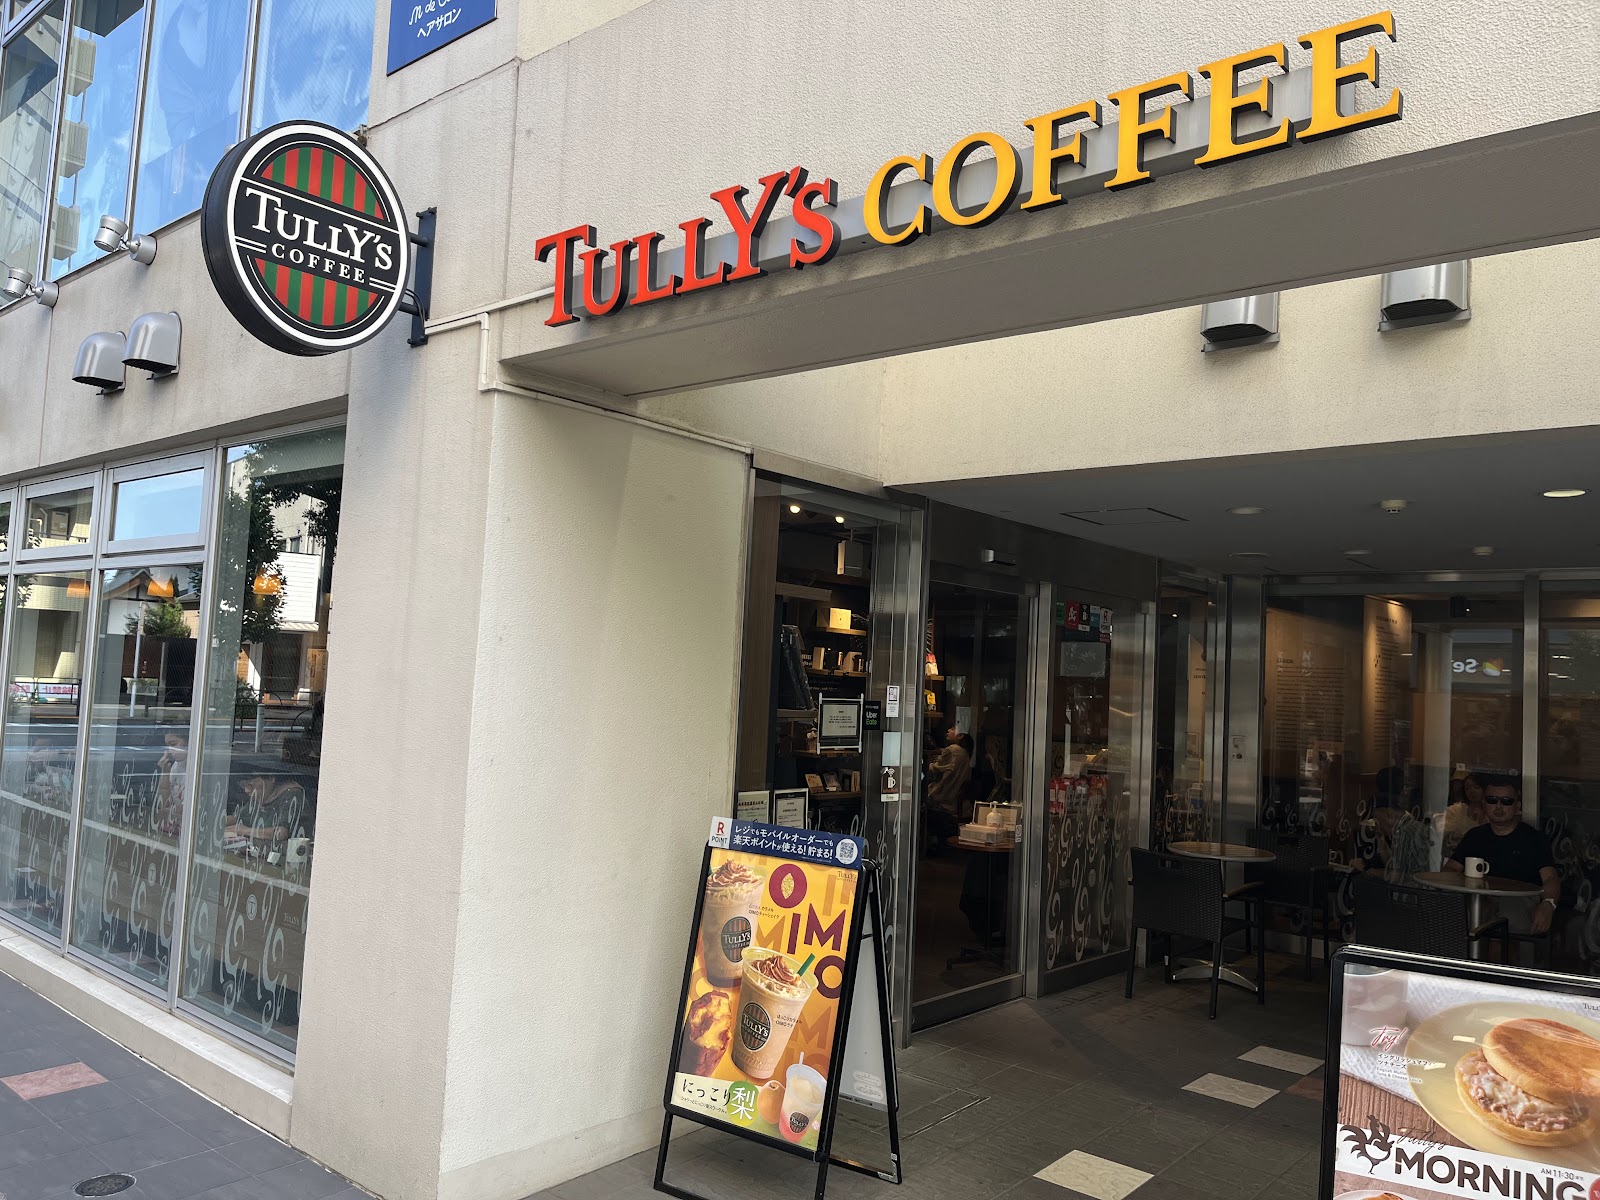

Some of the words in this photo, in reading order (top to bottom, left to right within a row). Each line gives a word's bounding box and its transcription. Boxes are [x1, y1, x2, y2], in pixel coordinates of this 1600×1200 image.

[417, 8, 462, 38] ヘアサロン
[535, 166, 842, 327] TULLY'S
[863, 10, 1403, 247] COFFEE
[245, 186, 393, 271] TULLY'S
[271, 243, 365, 284] COFFEE
[866, 711, 877, 719] Uber
[717, 821, 725, 834] R
[735, 825, 834, 847] レジでもモバイルオーダーでも
[712, 835, 728, 844] POINT
[808, 846, 833, 860] 貯まる!
[1582, 1002, 1600, 1010] TULL
[743, 1014, 769, 1037] TULLY'S
[1370, 1026, 1408, 1052] Try!
[1394, 1148, 1586, 1200] MORNING
